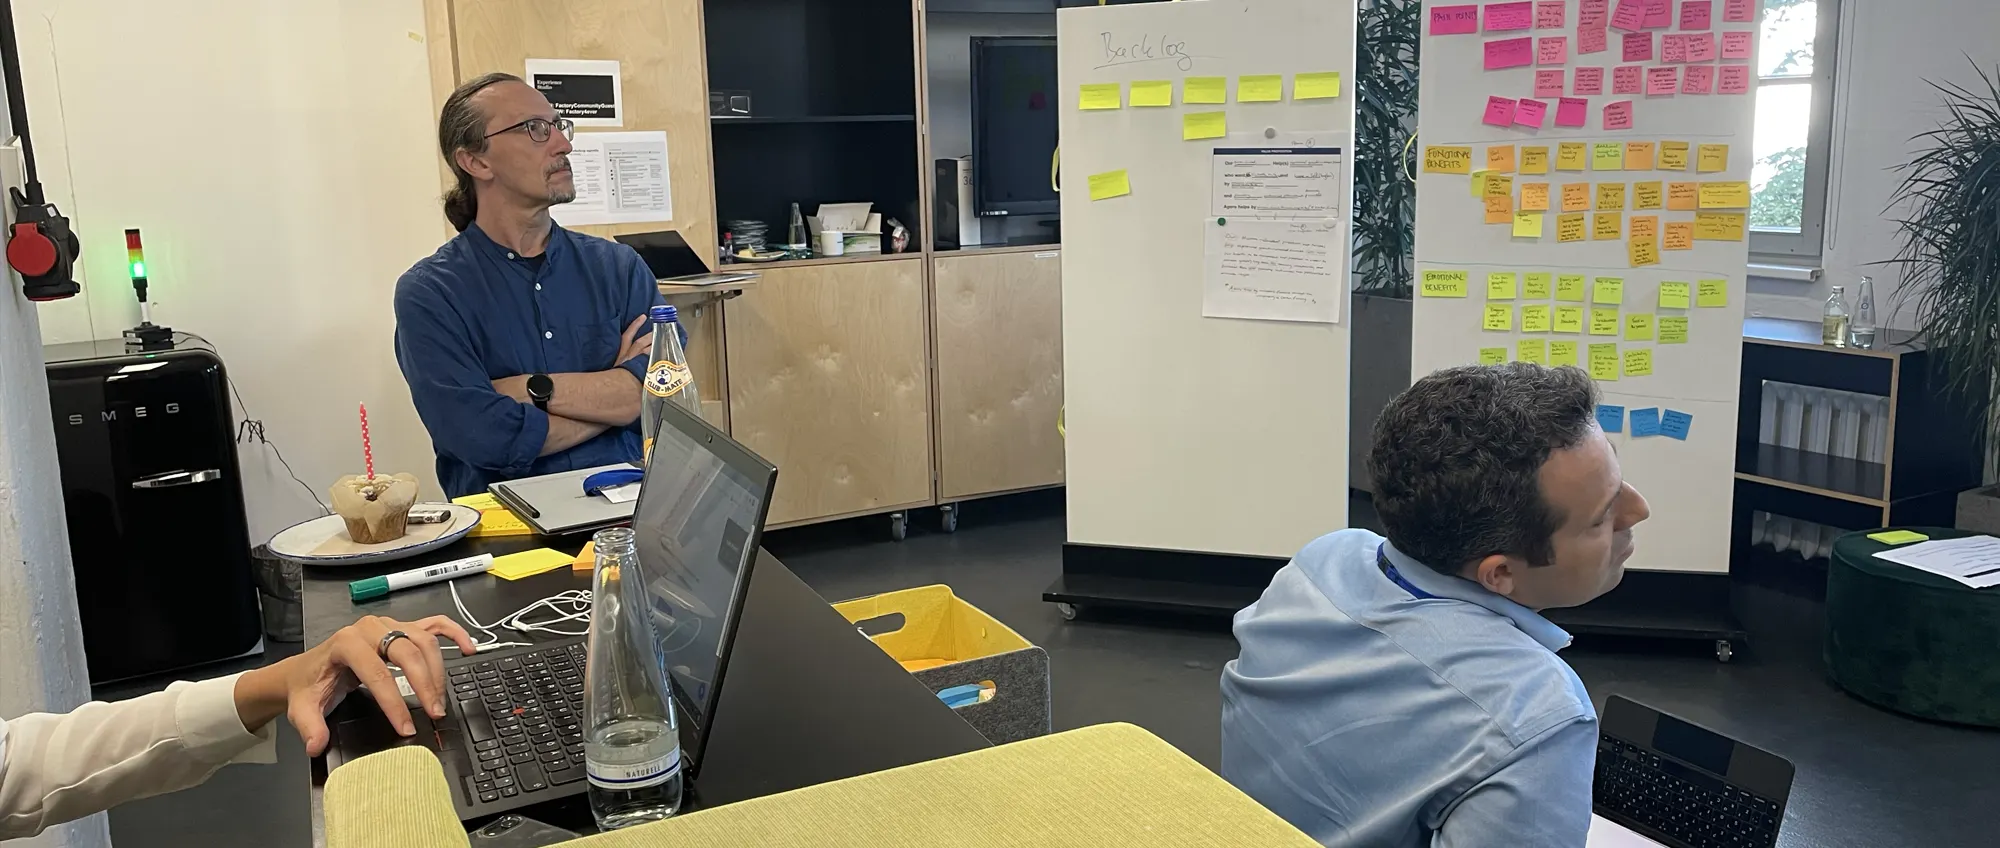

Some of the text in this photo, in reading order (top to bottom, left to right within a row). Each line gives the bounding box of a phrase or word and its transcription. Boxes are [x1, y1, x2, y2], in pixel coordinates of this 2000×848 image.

[1100, 31, 1192, 71] Backlog
[1427, 148, 1471, 159] FUNCTIONAL
[1426, 160, 1461, 169] BENEFITS
[1426, 272, 1464, 282] EMOTIONAL
[1425, 283, 1458, 292] BENEFITS
[69, 403, 180, 425] SMEG
[626, 764, 661, 778] NATURELL
